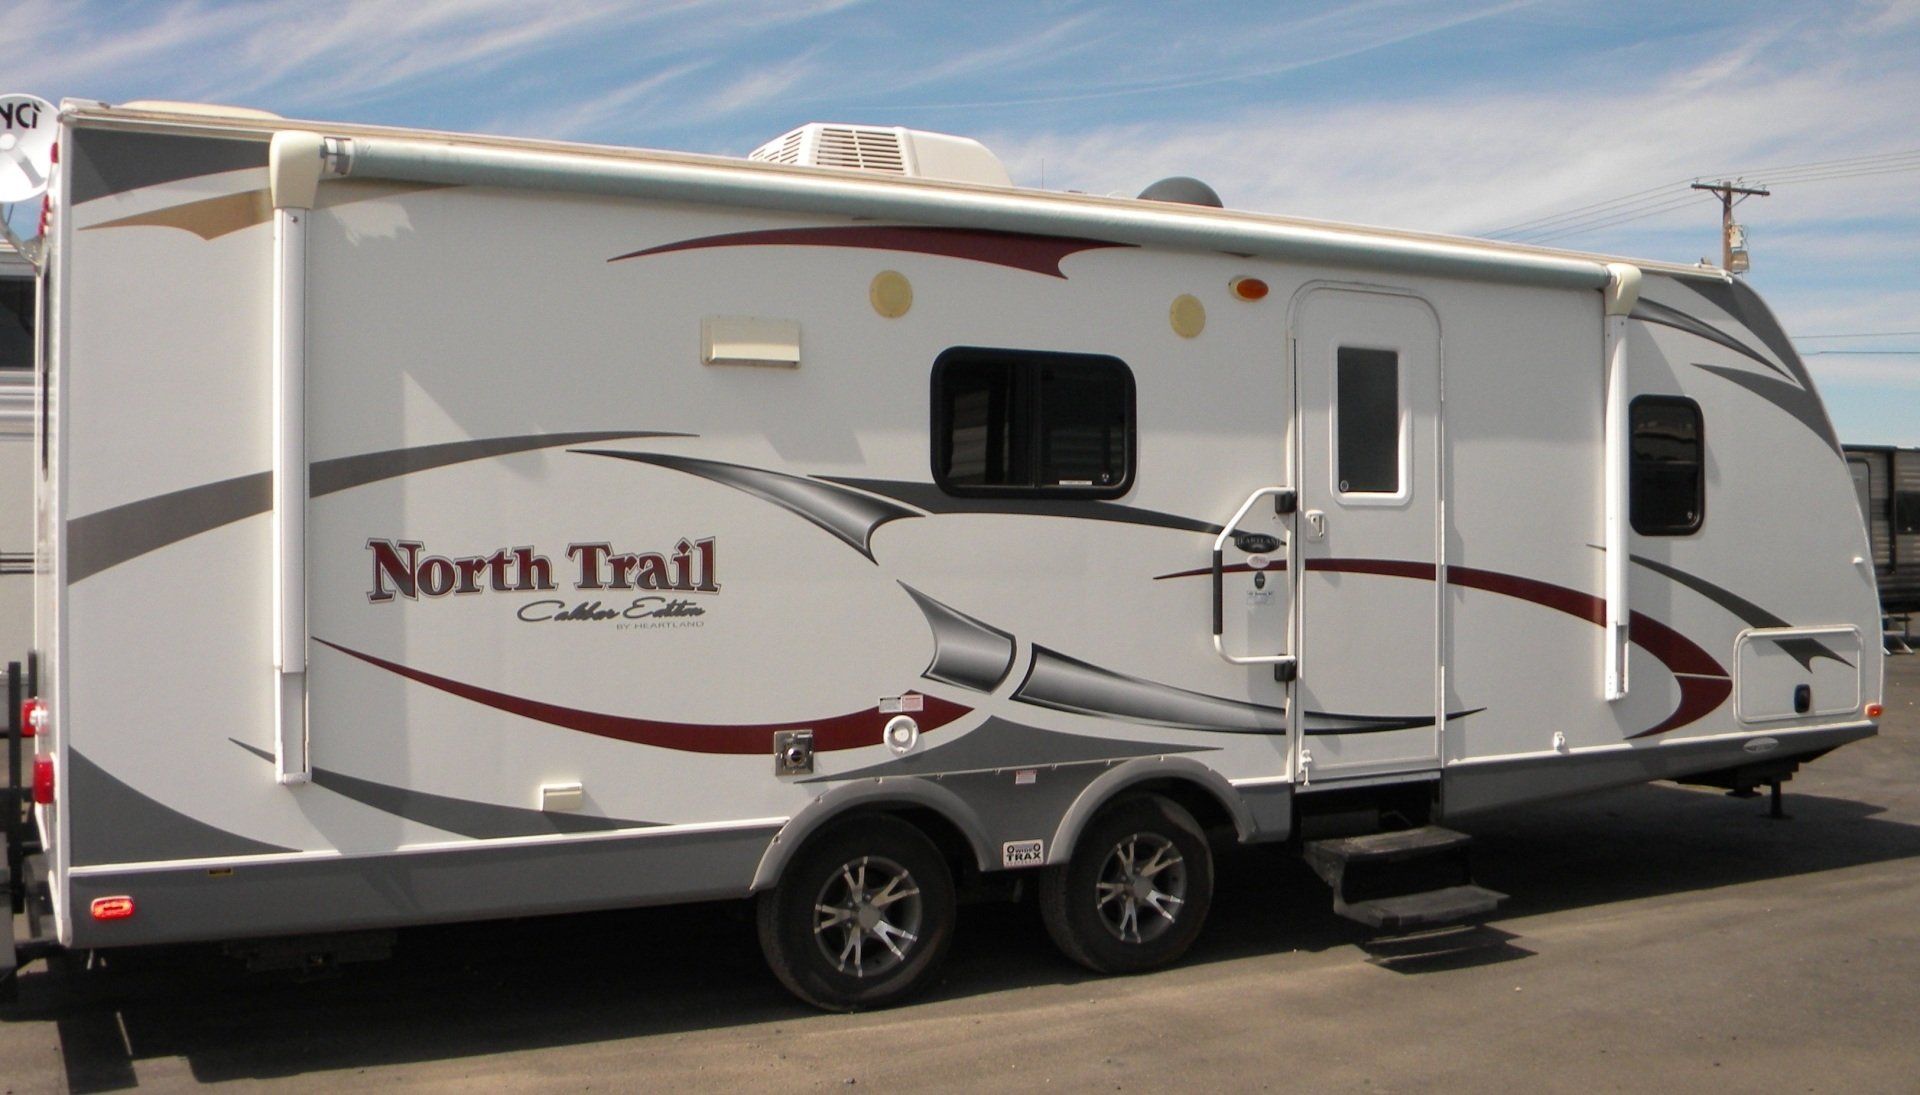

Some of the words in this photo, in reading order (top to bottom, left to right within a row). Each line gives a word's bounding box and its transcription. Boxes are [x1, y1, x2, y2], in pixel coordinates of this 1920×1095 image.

[366, 537, 559, 604] North
[565, 536, 723, 595] Trail
[616, 623, 630, 631] BY
[634, 621, 705, 630] HEARTLAND
[1007, 852, 1041, 861] TRAX
